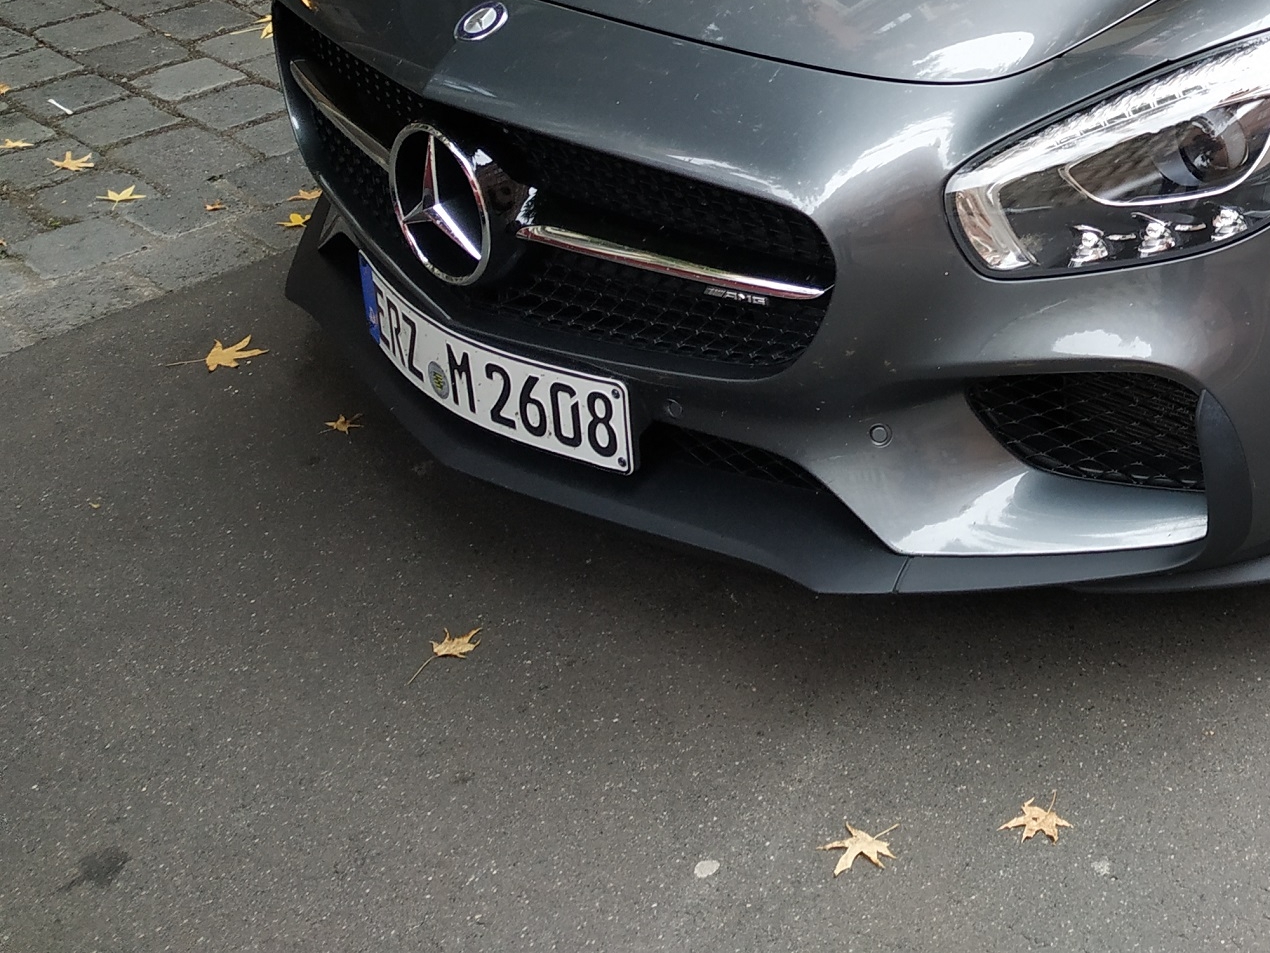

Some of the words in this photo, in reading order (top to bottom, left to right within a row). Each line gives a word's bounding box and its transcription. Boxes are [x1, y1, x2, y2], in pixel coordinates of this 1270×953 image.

[723, 291, 767, 306] AMG
[375, 286, 424, 382] ERZ
[446, 342, 476, 414] M
[485, 362, 618, 457] 2608
